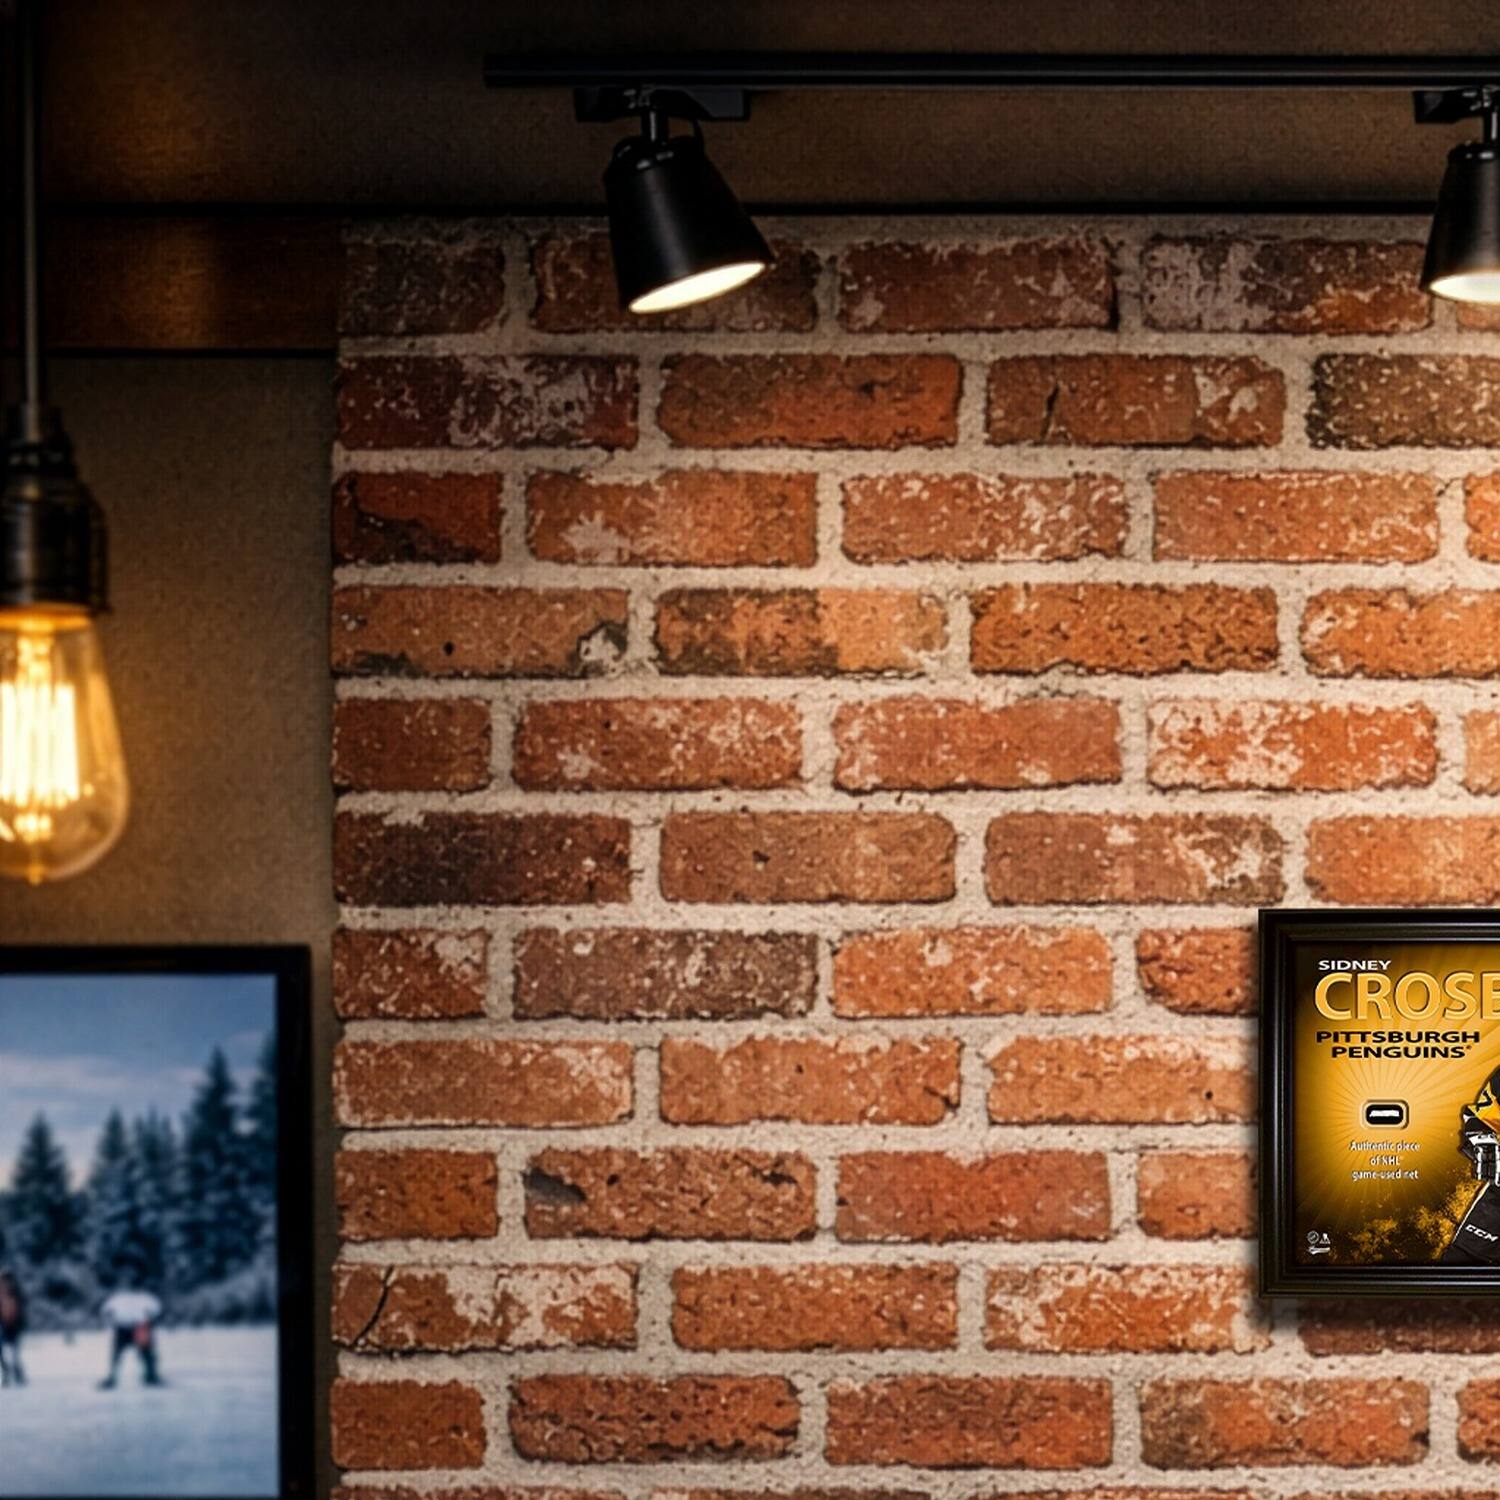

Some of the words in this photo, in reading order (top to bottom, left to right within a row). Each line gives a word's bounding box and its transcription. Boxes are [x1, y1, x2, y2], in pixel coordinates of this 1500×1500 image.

[1318, 960, 1391, 970] SIDNEY
[1316, 1031, 1480, 1043] PITTSBURGH
[1350, 1141, 1394, 1151] Authentic
[1370, 1155, 1380, 1165] of
